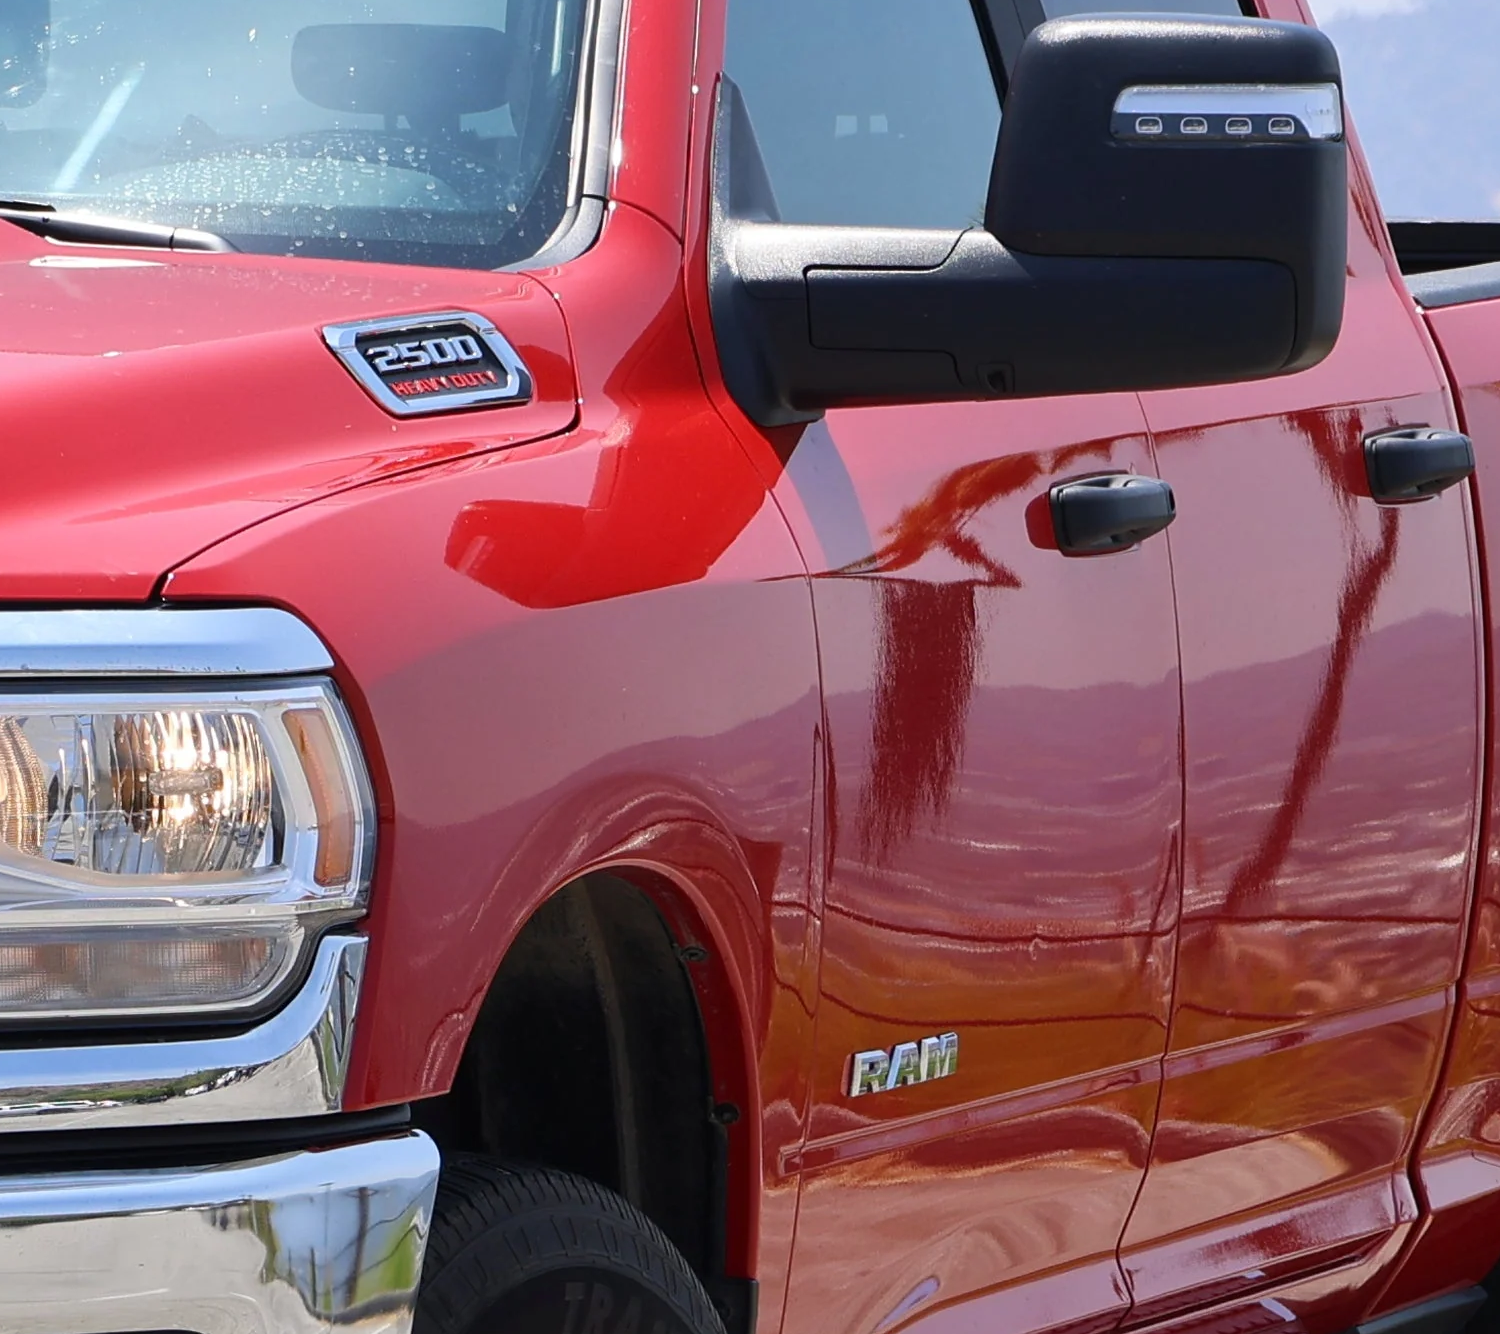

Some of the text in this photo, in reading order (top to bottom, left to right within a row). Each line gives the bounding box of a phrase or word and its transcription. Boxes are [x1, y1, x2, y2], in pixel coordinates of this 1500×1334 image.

[366, 335, 483, 373] 2500
[391, 370, 498, 396] HEAVY DUTY
[848, 1031, 959, 1098] RAM
